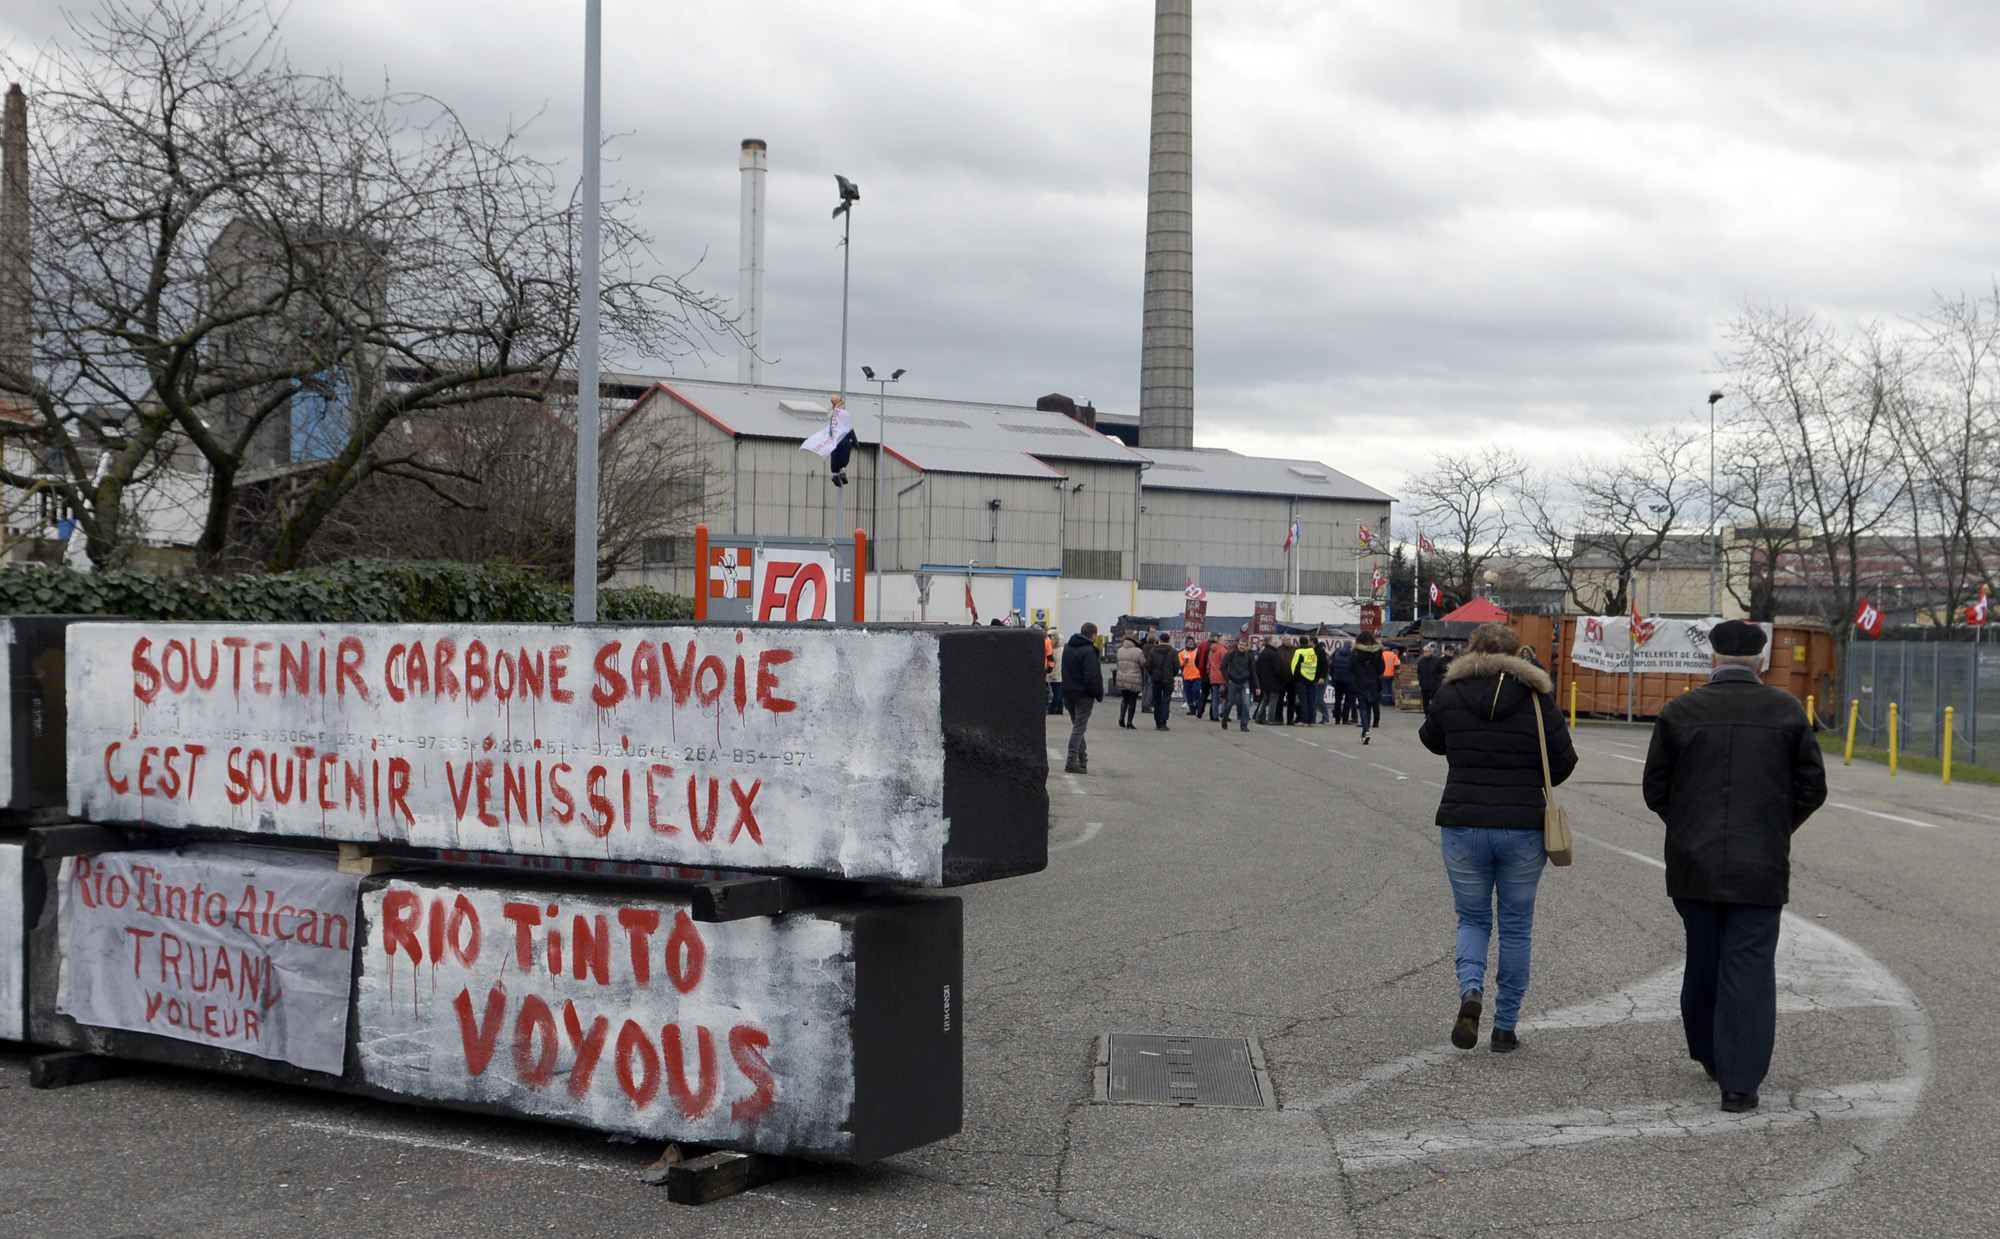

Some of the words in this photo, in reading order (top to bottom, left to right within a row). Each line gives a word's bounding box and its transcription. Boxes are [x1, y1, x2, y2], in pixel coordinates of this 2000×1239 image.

[758, 561, 828, 621] FO
[1857, 604, 1878, 630] FO
[385, 638, 574, 704] CARBONE
[74, 855, 130, 909] Rio
[131, 865, 227, 927] Tinto
[233, 884, 350, 951] Alcan
[382, 889, 482, 968] RIO
[144, 987, 260, 1042] VOLEUR
[453, 978, 777, 1125] VOYOUS
